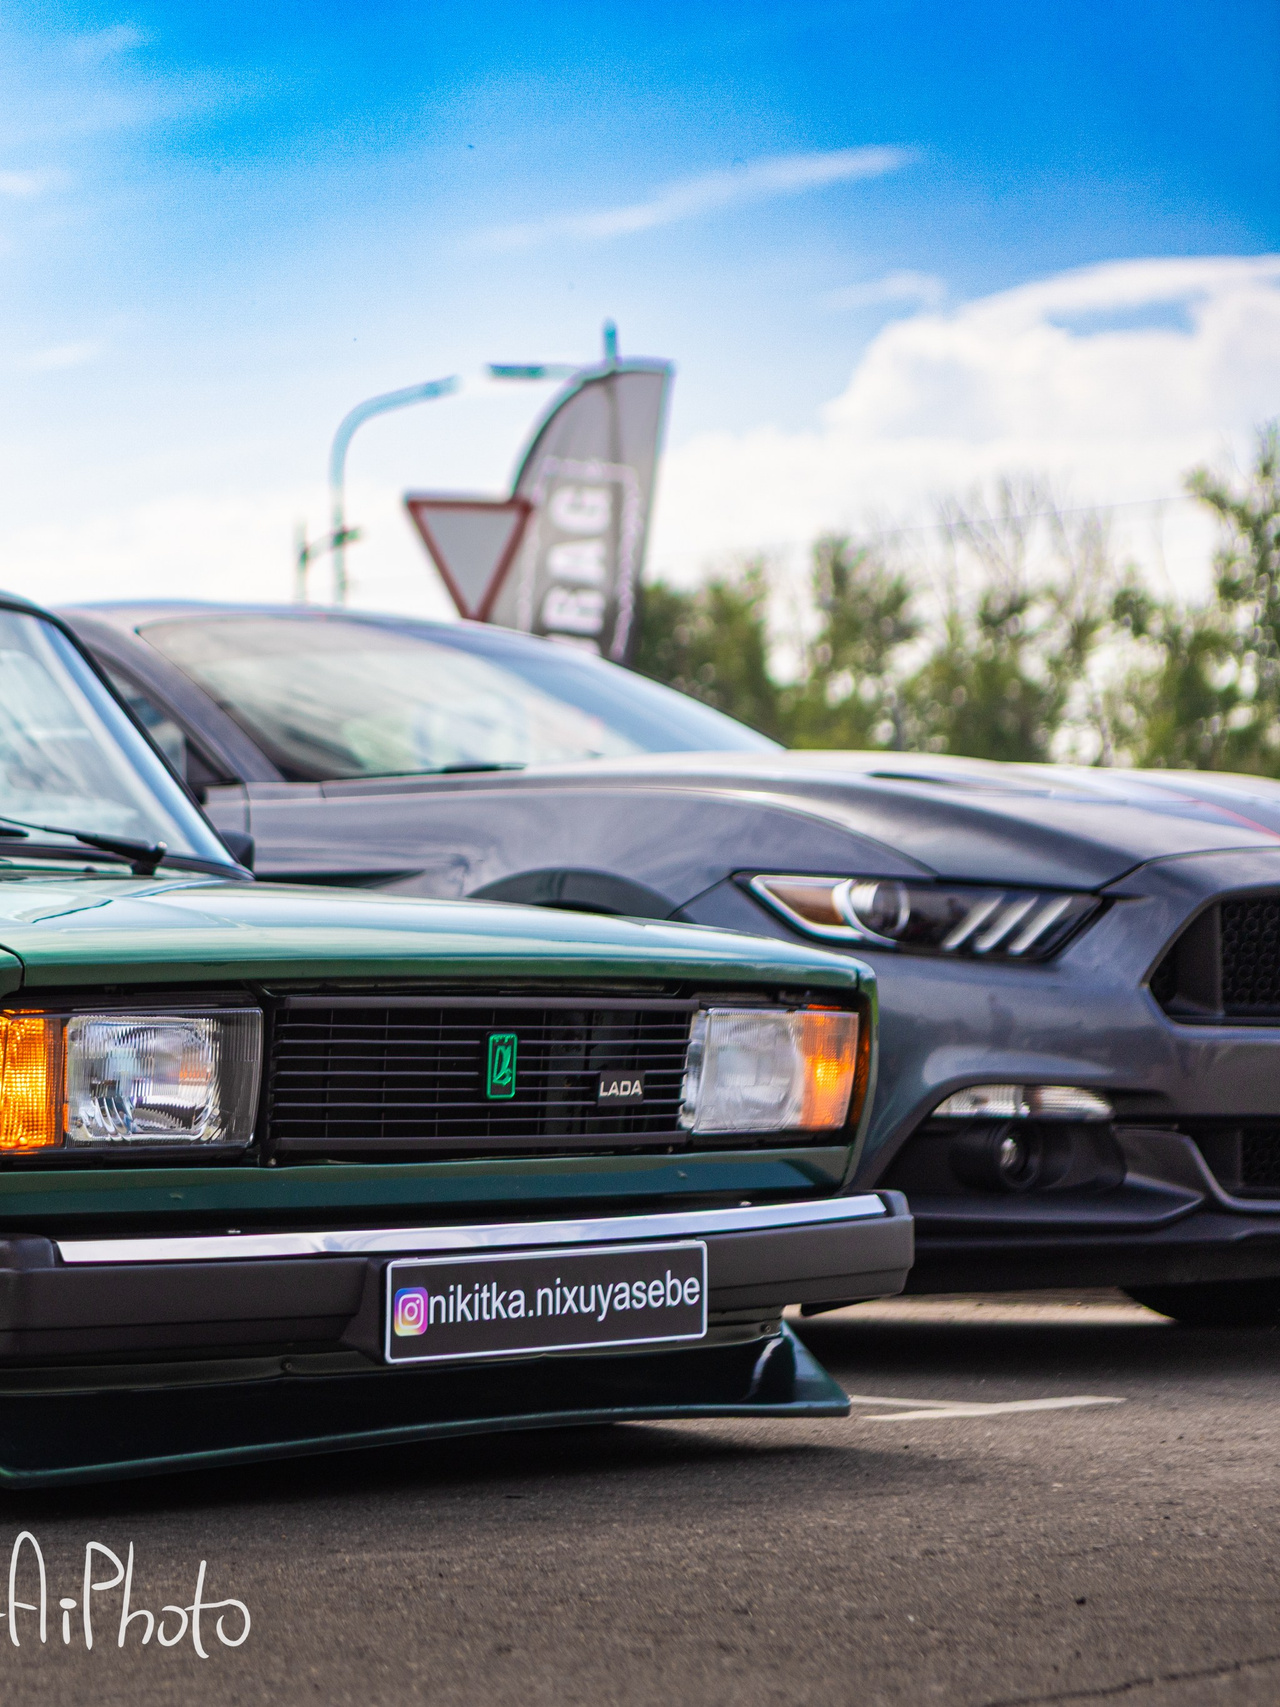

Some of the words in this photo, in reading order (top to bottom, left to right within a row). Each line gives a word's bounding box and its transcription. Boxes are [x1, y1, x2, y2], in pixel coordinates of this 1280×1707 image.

[542, 487, 614, 656] RAG
[598, 1079, 643, 1097] LADA
[428, 1269, 701, 1325] nikitka.nixuyasebe
